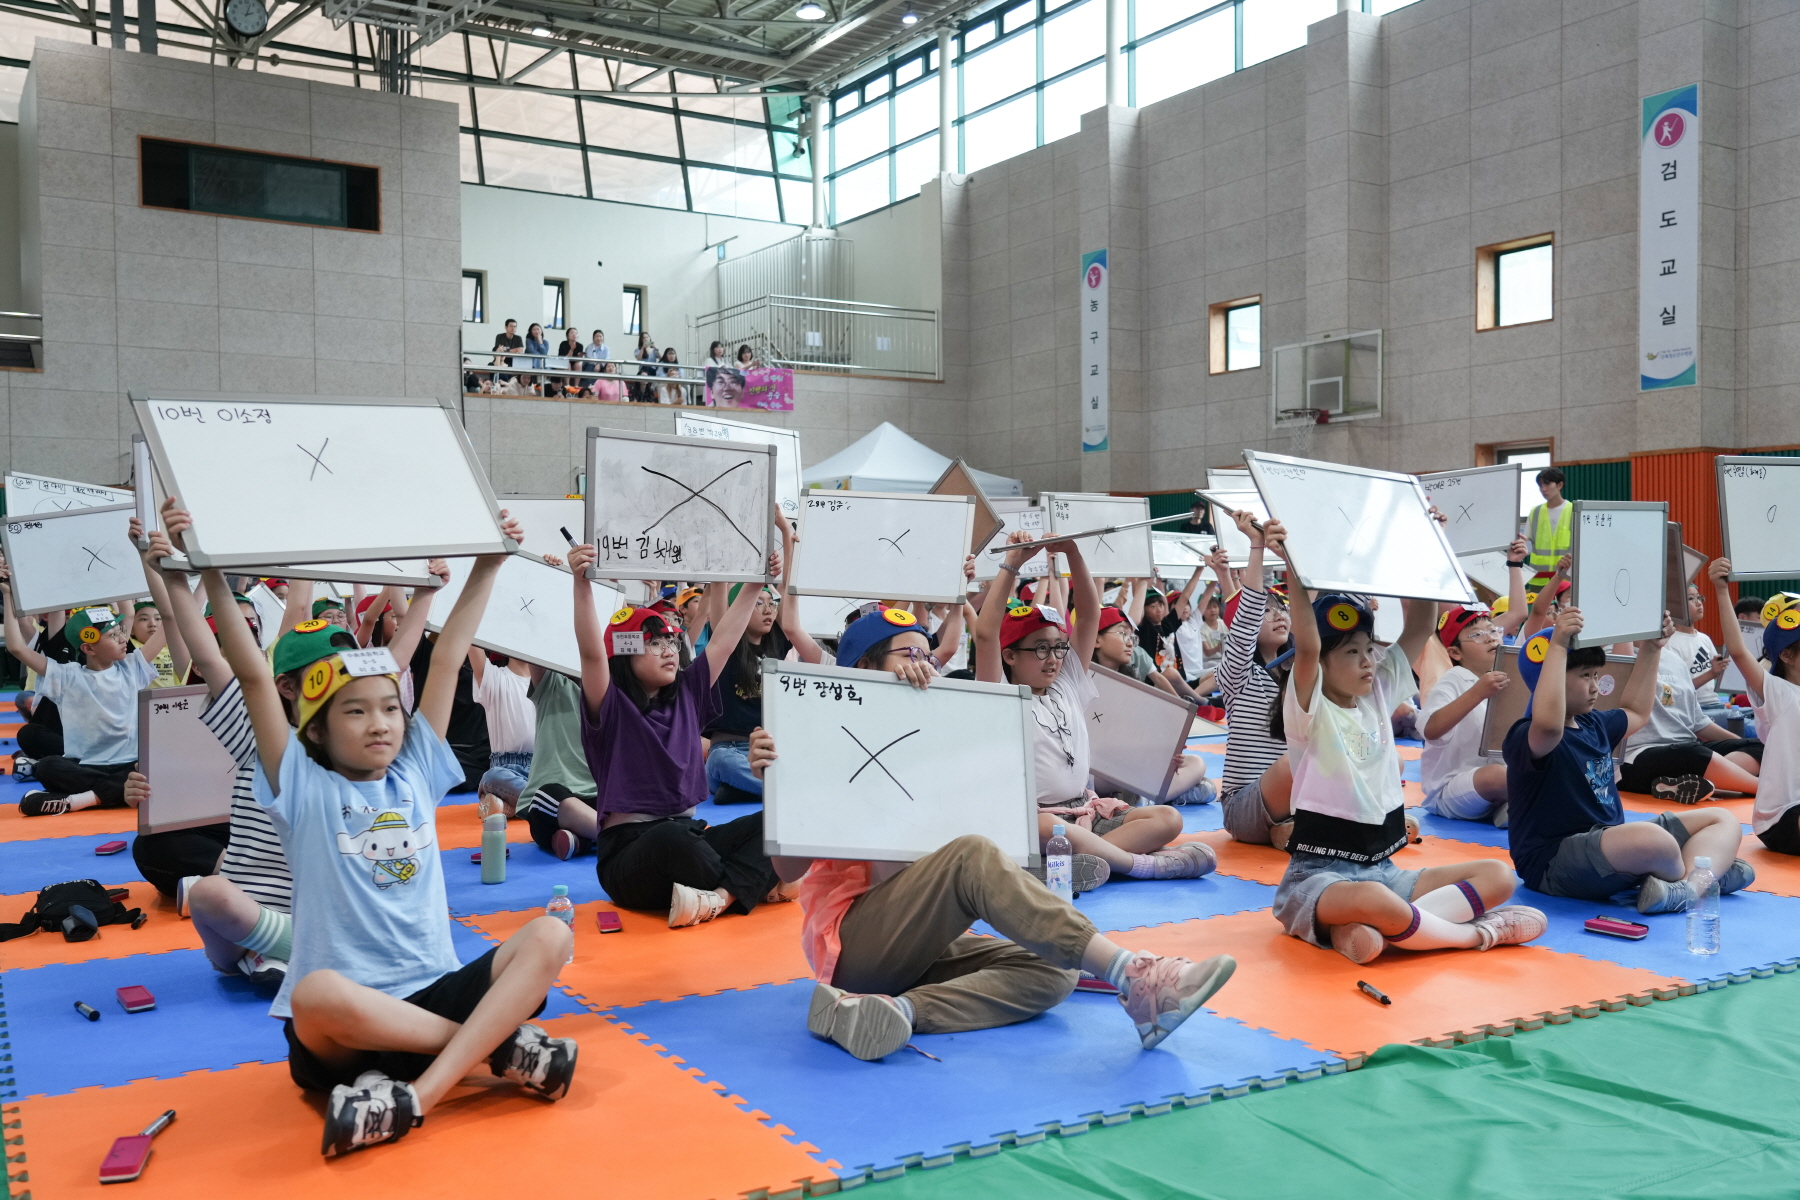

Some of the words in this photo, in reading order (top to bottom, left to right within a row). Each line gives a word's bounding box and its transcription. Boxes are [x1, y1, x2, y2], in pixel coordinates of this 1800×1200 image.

[157, 406, 206, 424] 10번
[217, 407, 272, 424] 이소정
[1054, 501, 1070, 511] 36번
[597, 535, 628, 567] 19번
[615, 610, 628, 621] 19
[303, 621, 319, 629] 20
[83, 630, 95, 640] 50
[1532, 643, 1542, 656] 7
[309, 670, 324, 690] 10
[1296, 843, 1327, 855] ROLLING
[1327, 848, 1335, 856] IN
[1337, 850, 1350, 859] THE
[1350, 853, 1368, 862] DEEP
[1048, 861, 1064, 869] Milkis
